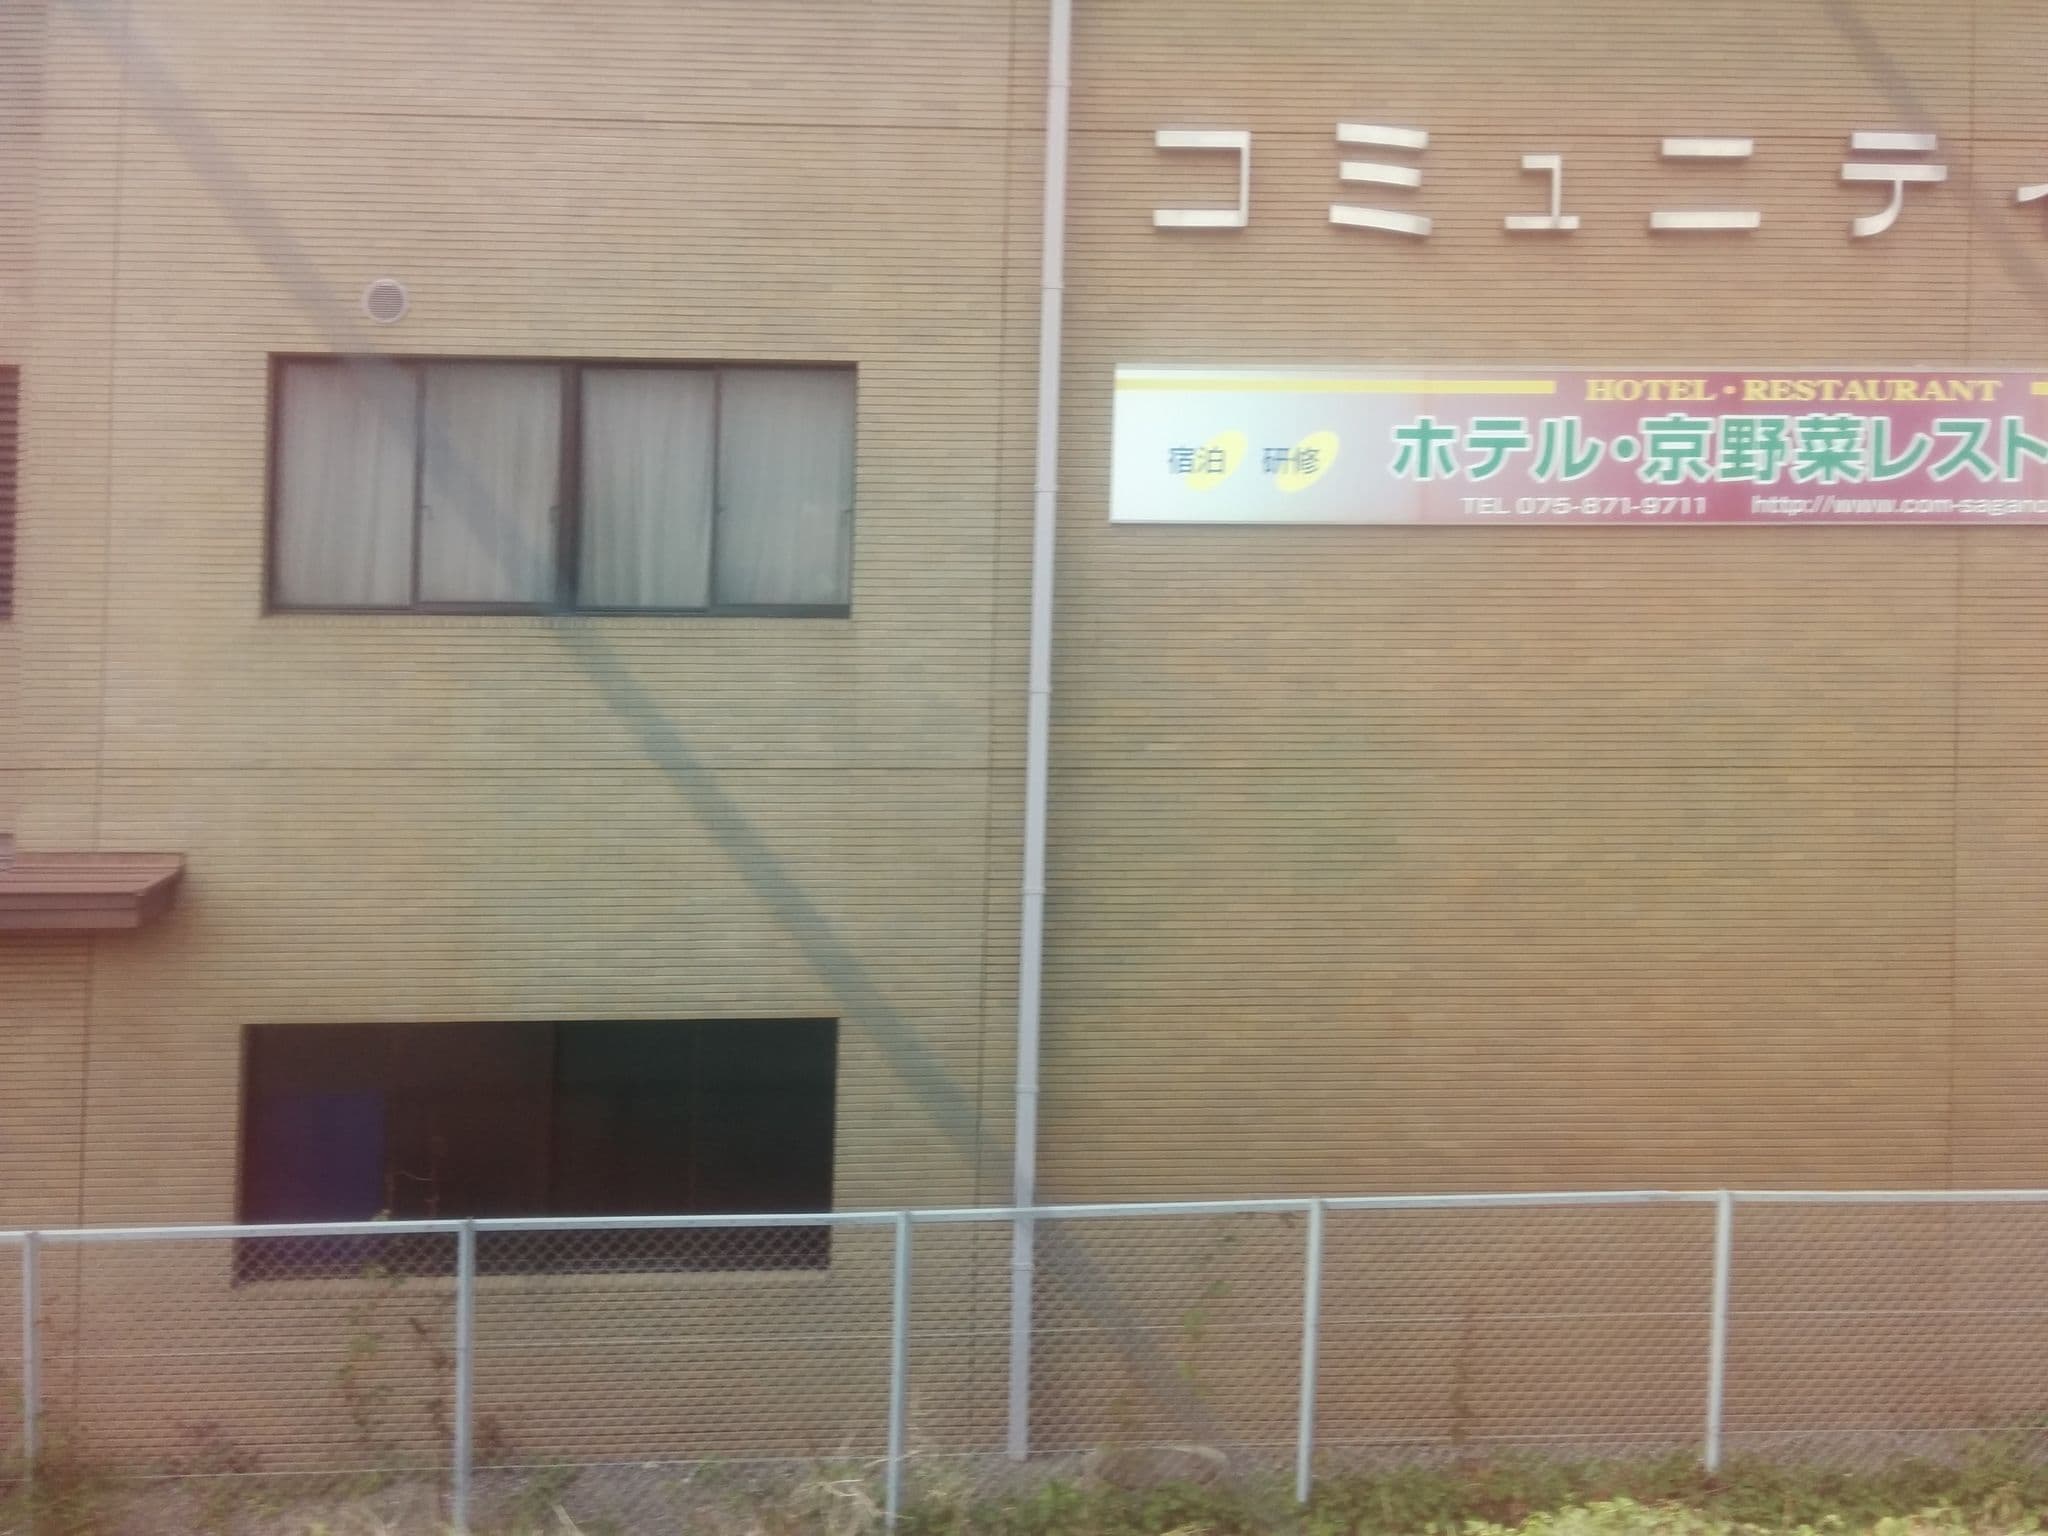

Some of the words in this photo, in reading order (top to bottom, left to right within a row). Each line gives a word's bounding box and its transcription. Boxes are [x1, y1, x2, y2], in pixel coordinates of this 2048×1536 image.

[1167, 446, 1227, 474] 宿泊
[1262, 446, 1321, 474] 研修
[1391, 413, 2048, 485] ホテル・京野菜レスト
[1462, 496, 1510, 515] TEL
[1515, 496, 1707, 515] 075-871-9711
